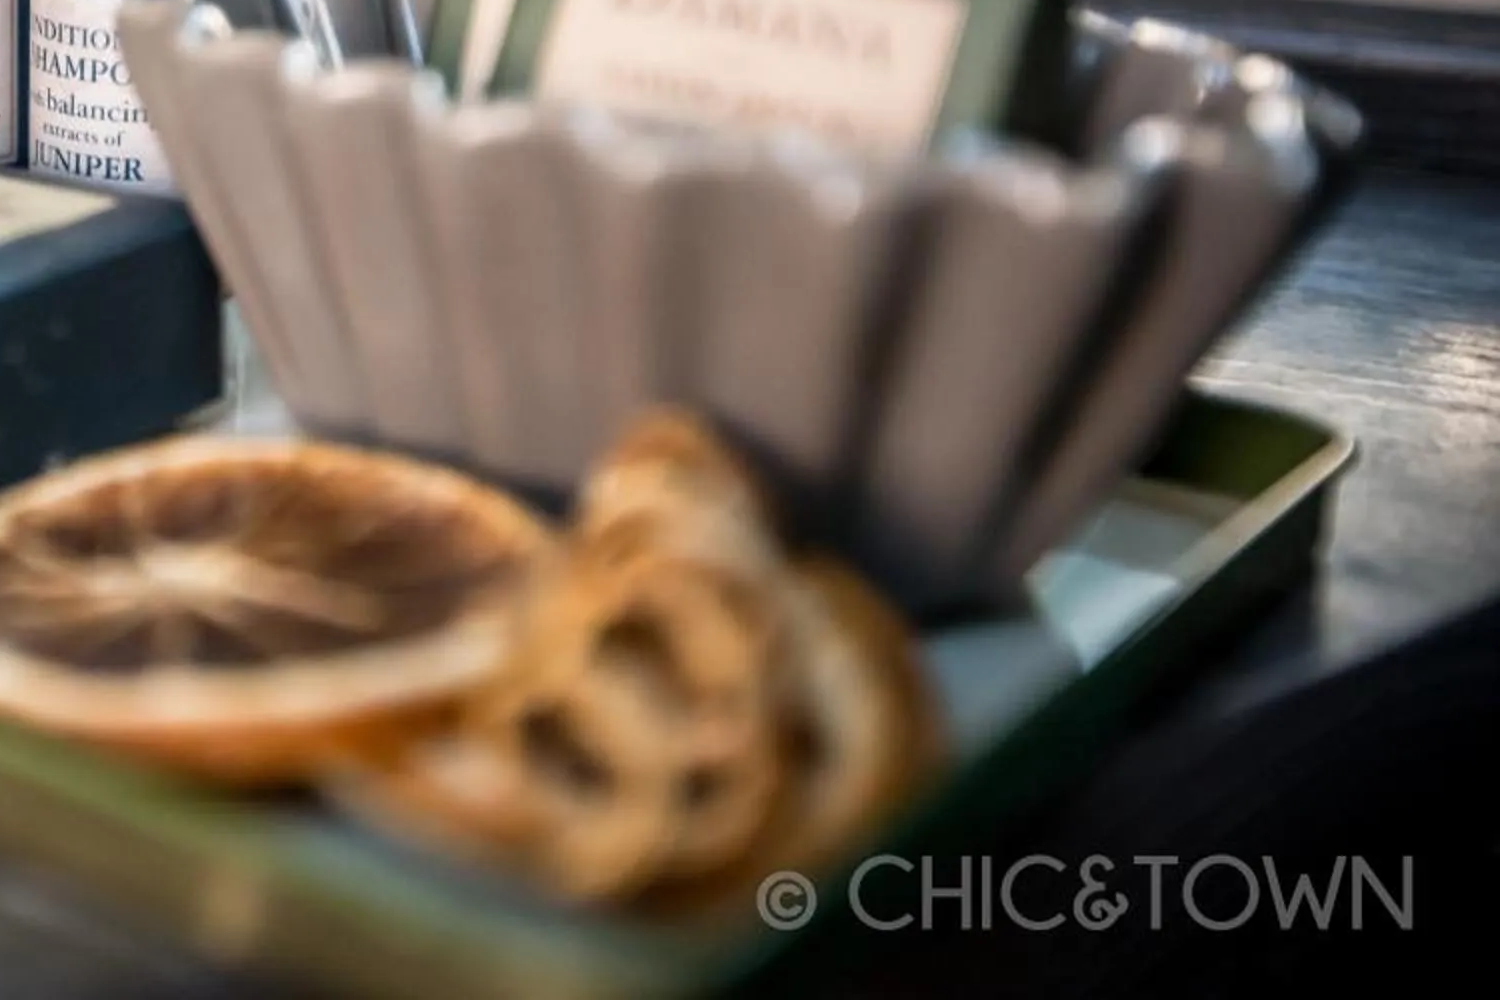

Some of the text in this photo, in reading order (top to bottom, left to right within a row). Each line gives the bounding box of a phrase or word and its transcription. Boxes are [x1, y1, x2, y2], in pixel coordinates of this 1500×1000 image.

[32, 42, 132, 87] HAMPO
[45, 88, 152, 125] balancin
[43, 120, 125, 147] extracts of
[33, 138, 144, 182] JUNIPER
